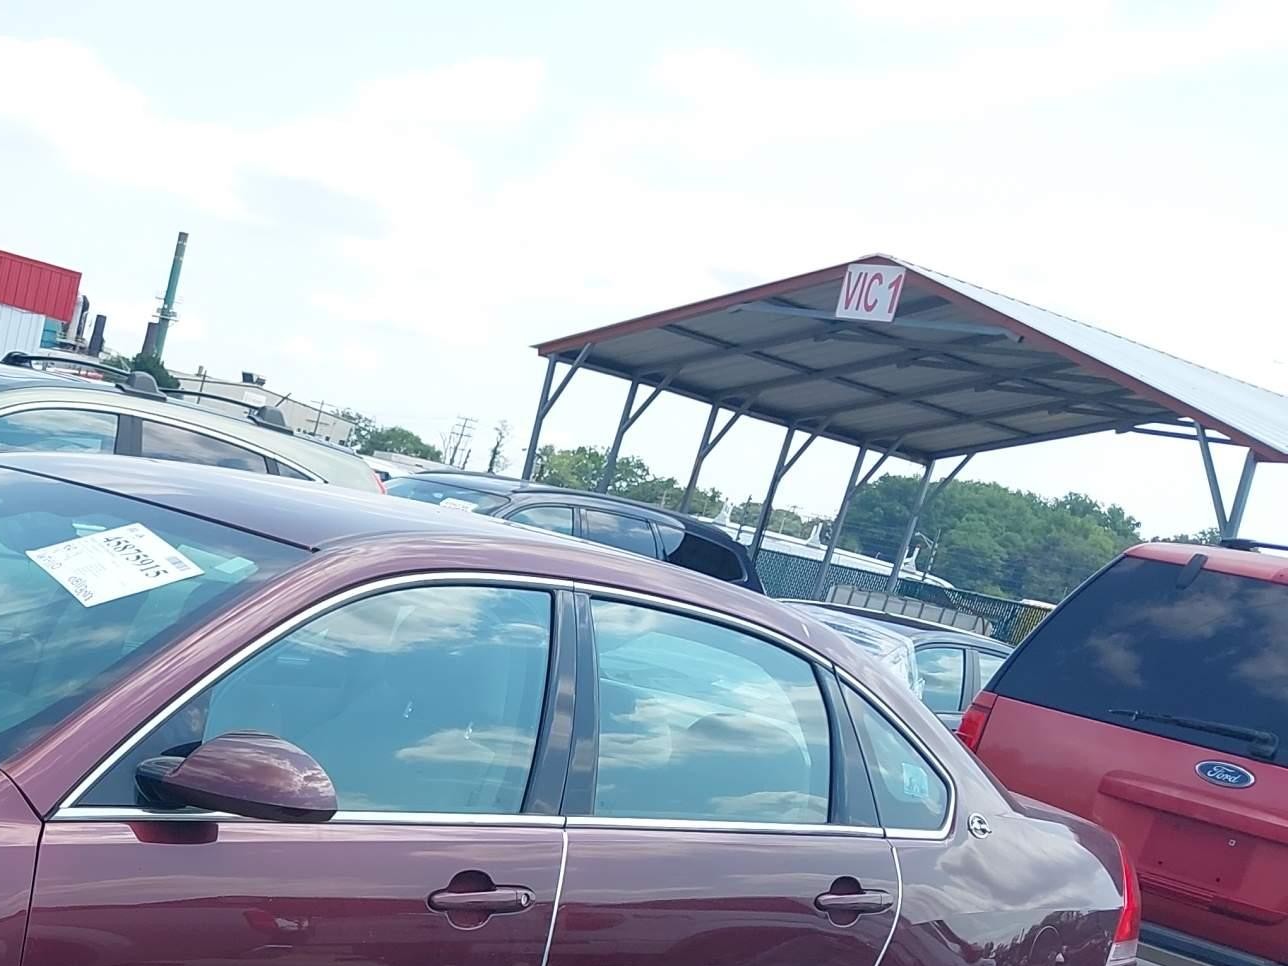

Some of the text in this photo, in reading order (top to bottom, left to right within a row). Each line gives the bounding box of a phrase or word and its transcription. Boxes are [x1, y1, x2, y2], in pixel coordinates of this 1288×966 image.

[844, 272, 903, 313] VIC 1
[103, 535, 169, 578] 45875915
[1207, 765, 1241, 783] Ford
